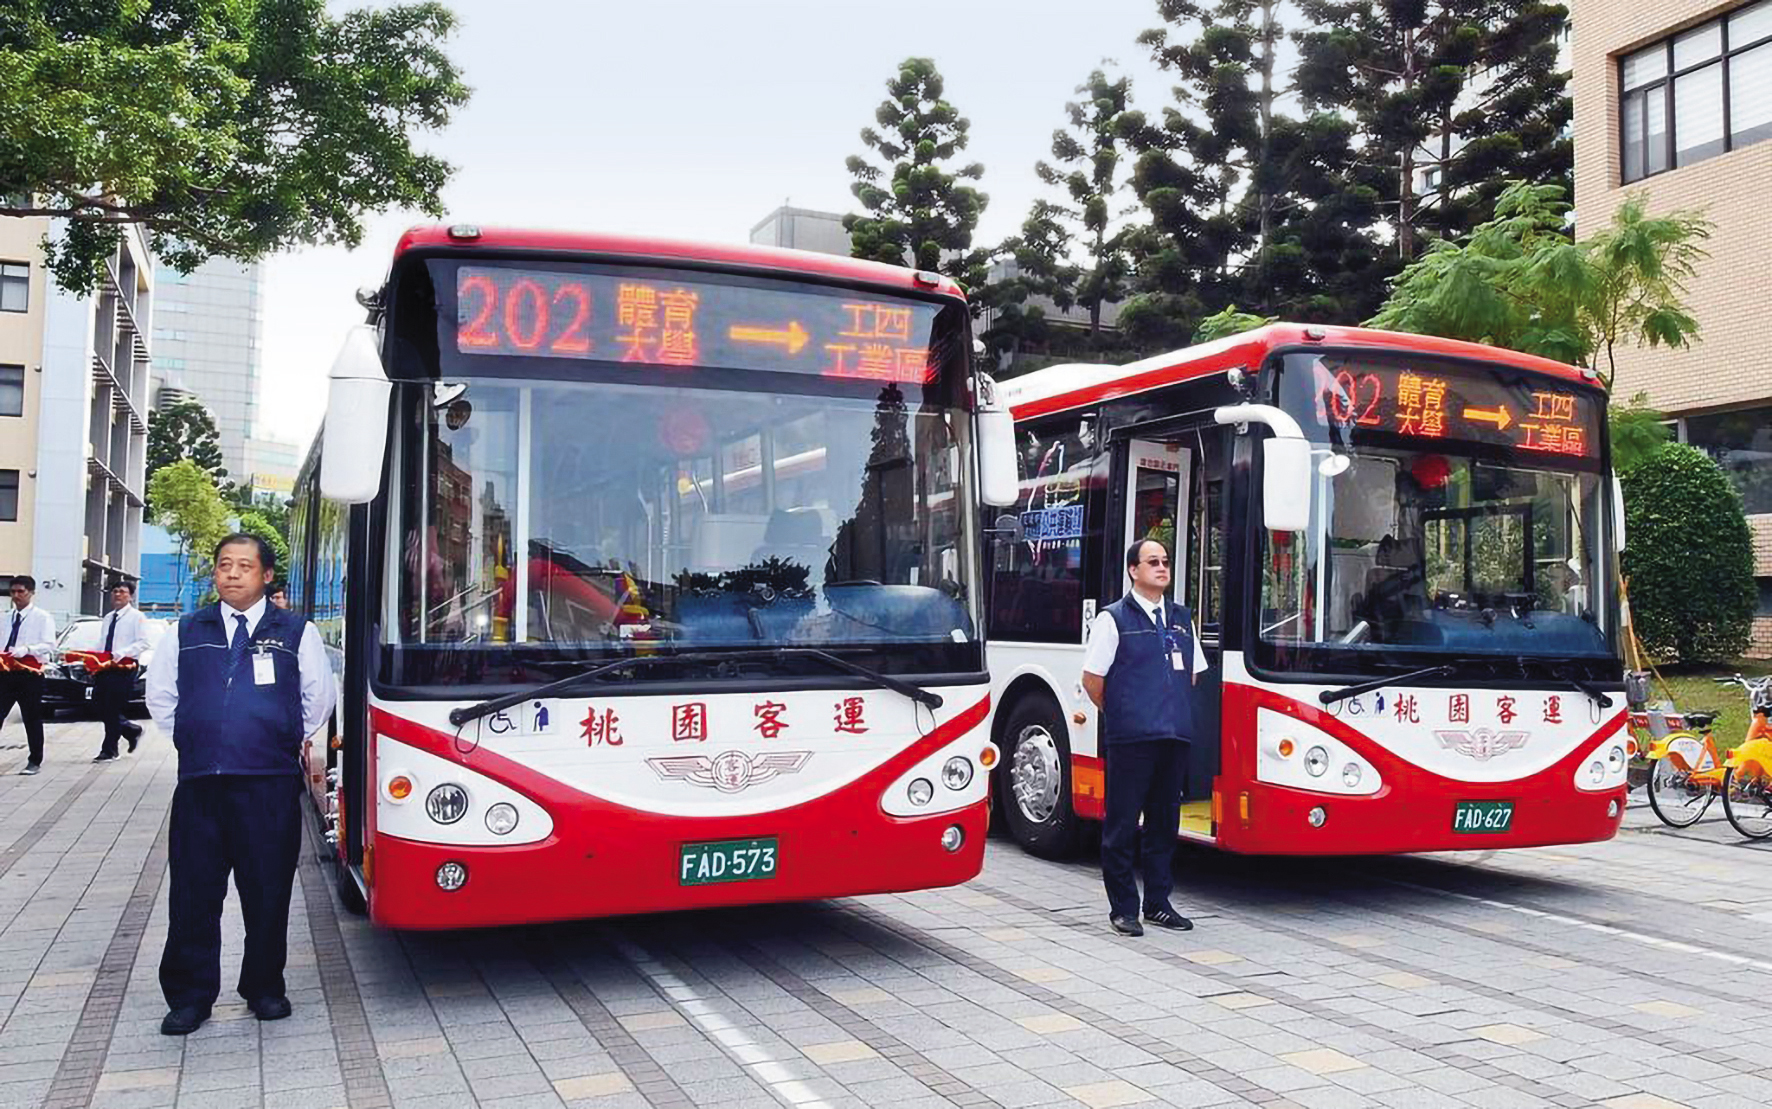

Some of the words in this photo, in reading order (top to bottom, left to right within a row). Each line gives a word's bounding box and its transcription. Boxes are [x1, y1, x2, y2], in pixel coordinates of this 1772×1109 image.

[457, 275, 592, 354] 202
[617, 284, 698, 328] 體育
[838, 303, 909, 341] 工四
[613, 328, 698, 364] 大學
[820, 343, 933, 382] 工業區
[1398, 371, 1446, 410] 體育
[1528, 393, 1575, 421] 工四
[1395, 407, 1444, 437] 大學
[1516, 423, 1584, 456] 工業區
[579, 696, 871, 748] 桃園客運
[1394, 692, 1564, 725] 桃園客運
